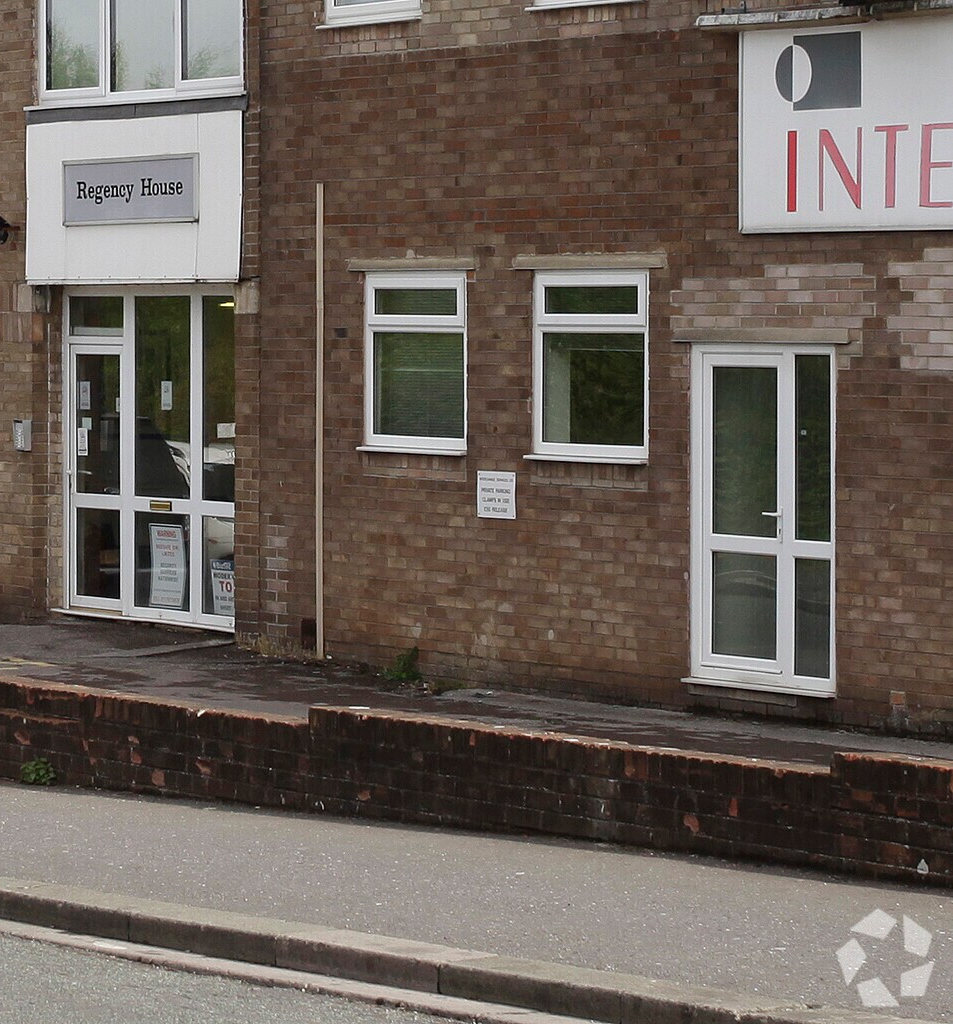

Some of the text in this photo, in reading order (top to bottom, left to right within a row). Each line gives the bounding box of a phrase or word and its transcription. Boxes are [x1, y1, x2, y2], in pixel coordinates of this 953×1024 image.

[787, 122, 953, 213] INTE
[76, 177, 183, 204] Regency House
[219, 580, 233, 593] TO
